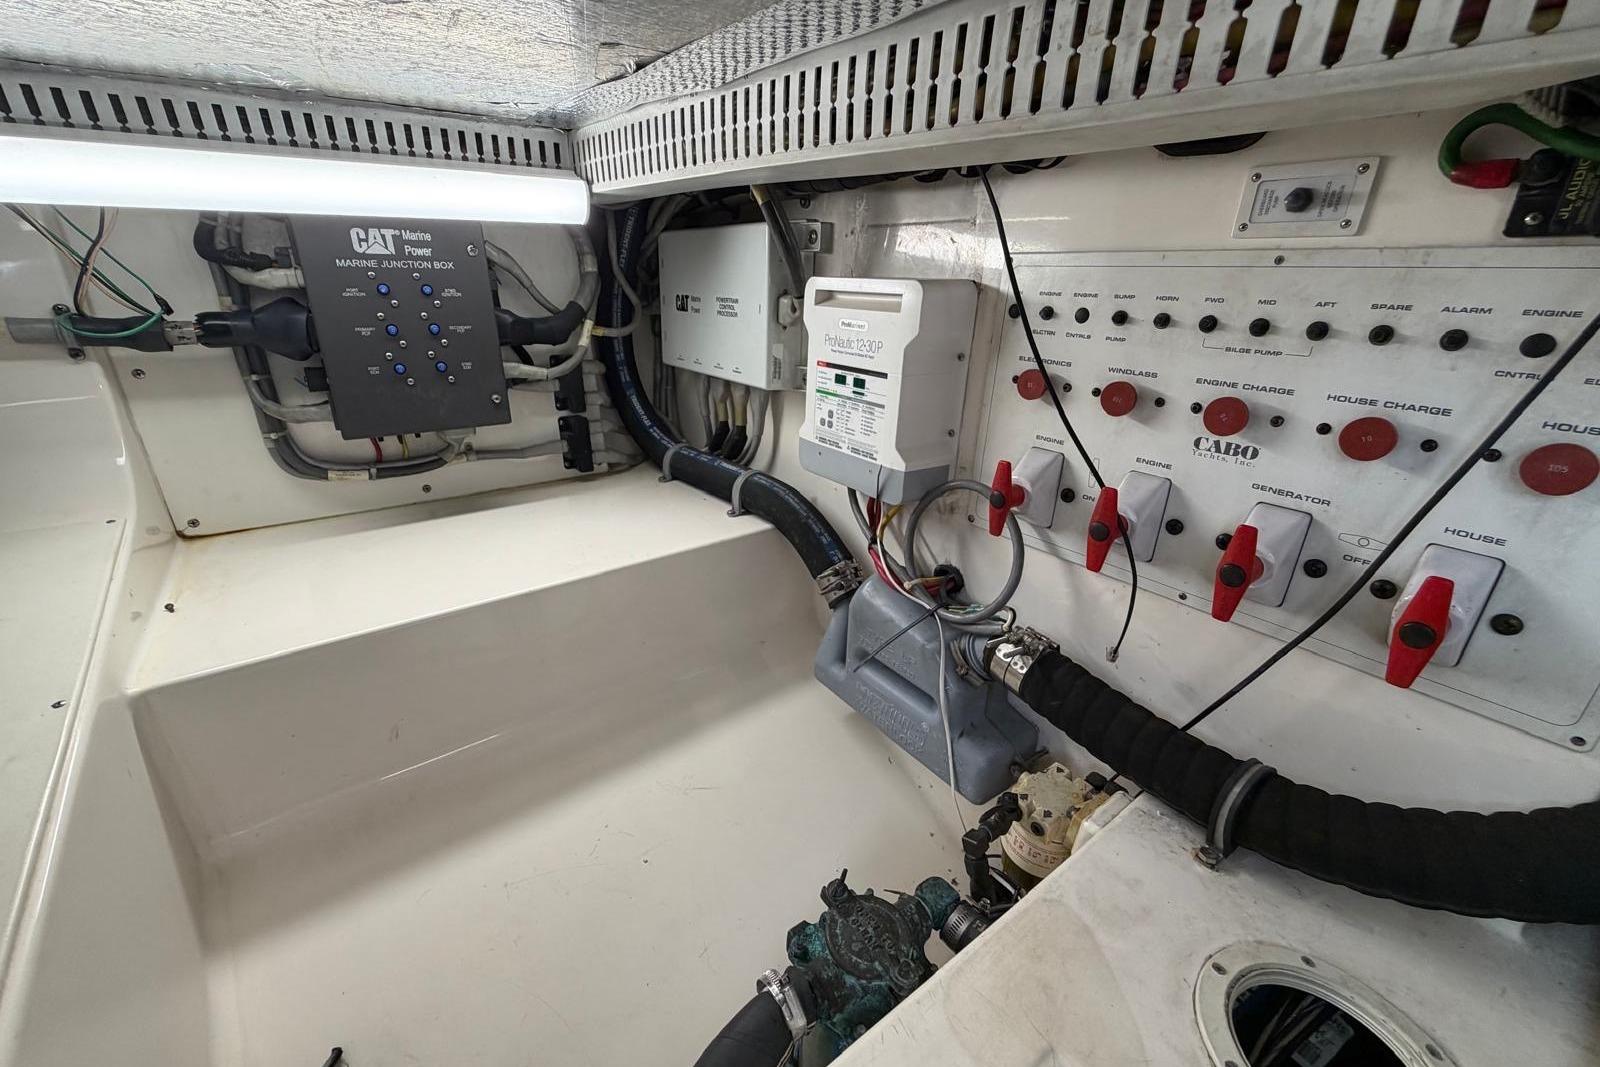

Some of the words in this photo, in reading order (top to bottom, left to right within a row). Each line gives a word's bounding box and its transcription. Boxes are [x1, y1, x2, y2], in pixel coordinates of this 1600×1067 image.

[402, 229, 431, 242] Marine
[404, 245, 432, 257] Power
[336, 258, 379, 269] MARINE
[381, 260, 431, 270] JUNCTION
[434, 261, 455, 270] BOX
[1114, 293, 1136, 301] SUMP
[1257, 298, 1277, 306] MID
[1370, 303, 1413, 311] SPARE
[1440, 306, 1493, 315] ALARM
[1522, 309, 1584, 319] ENGINE
[1224, 346, 1252, 355] BILGE
[1254, 349, 1283, 357] PUMP
[1019, 355, 1072, 367] ELECRONICS
[1107, 366, 1159, 379] WINDLASS
[1195, 377, 1239, 390] ENGINE
[1242, 382, 1296, 397] CHARGE
[1326, 393, 1378, 407] HOUSE
[1382, 400, 1453, 417] CHARGE
[1035, 434, 1065, 446] ENGINE
[1193, 436, 1260, 460] CABO
[1136, 456, 1173, 471] ENGINE
[1234, 457, 1256, 468] Inc.
[1082, 494, 1096, 502] ON
[1251, 482, 1331, 507] GENERATOR
[1444, 526, 1508, 547] HOUSE
[1342, 554, 1371, 566] OFF
